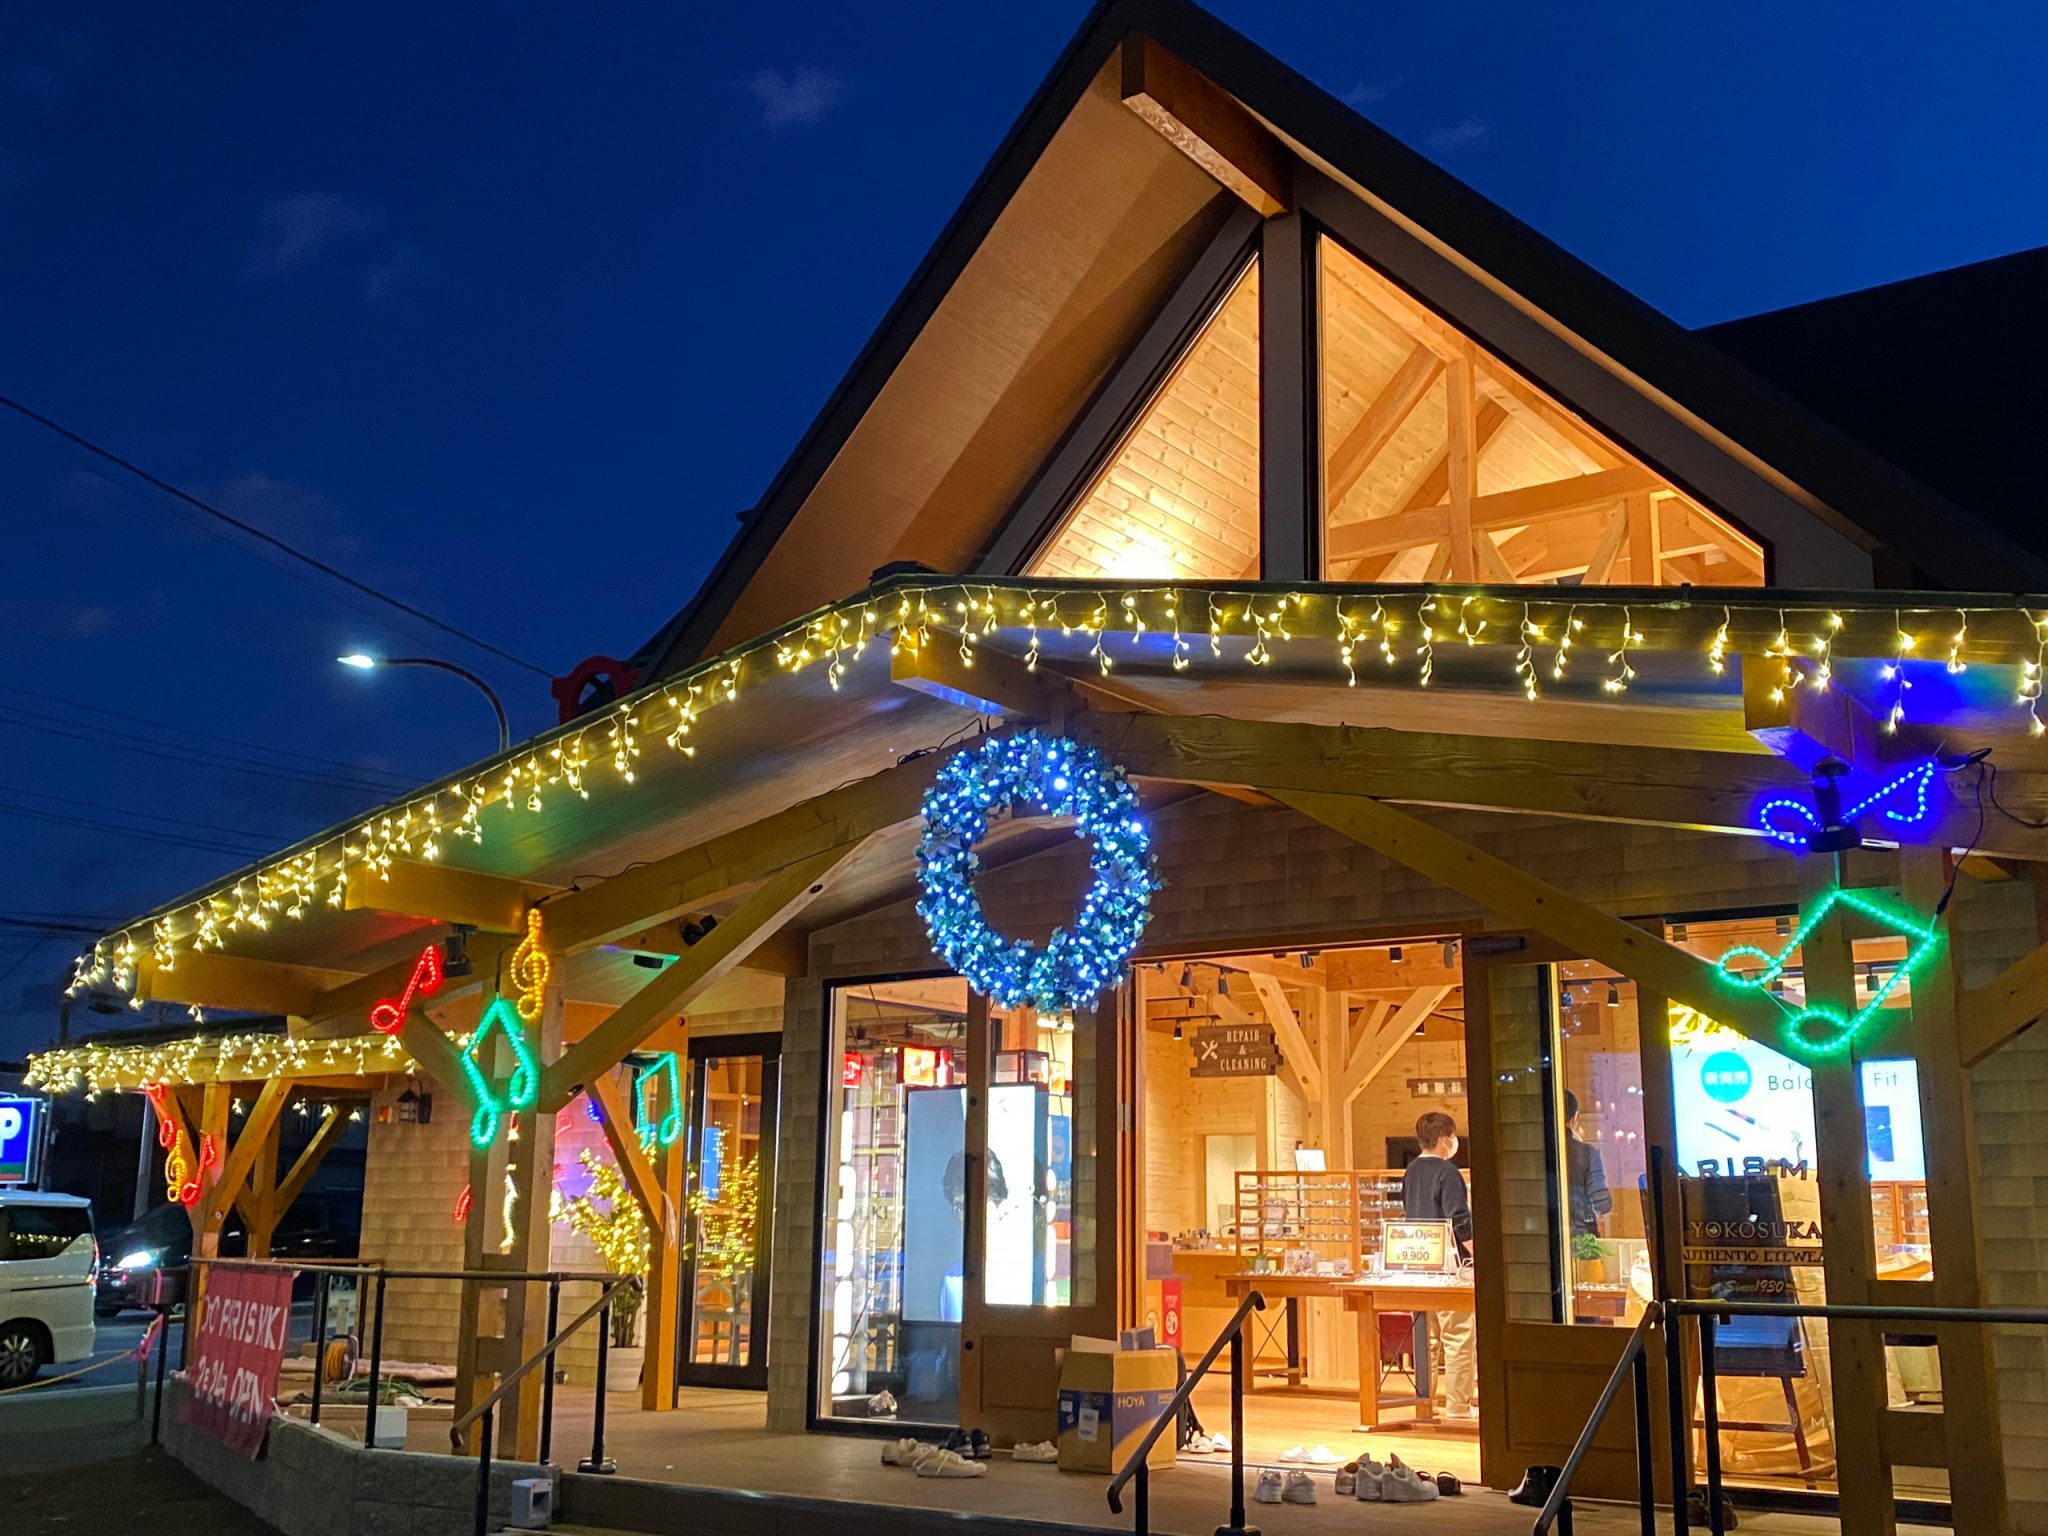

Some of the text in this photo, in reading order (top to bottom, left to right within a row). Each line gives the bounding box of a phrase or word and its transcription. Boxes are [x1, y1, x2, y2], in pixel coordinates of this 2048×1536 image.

[1226, 1030, 1260, 1043] REPAIR
[1239, 1044, 1247, 1056] &
[1220, 1057, 1267, 1071] CLEANING
[1873, 1072, 1898, 1088] Fit
[0, 1107, 22, 1159] P
[1690, 1221, 1822, 1240] YOKOSUKA
[1117, 1395, 1146, 1409] HOYA
